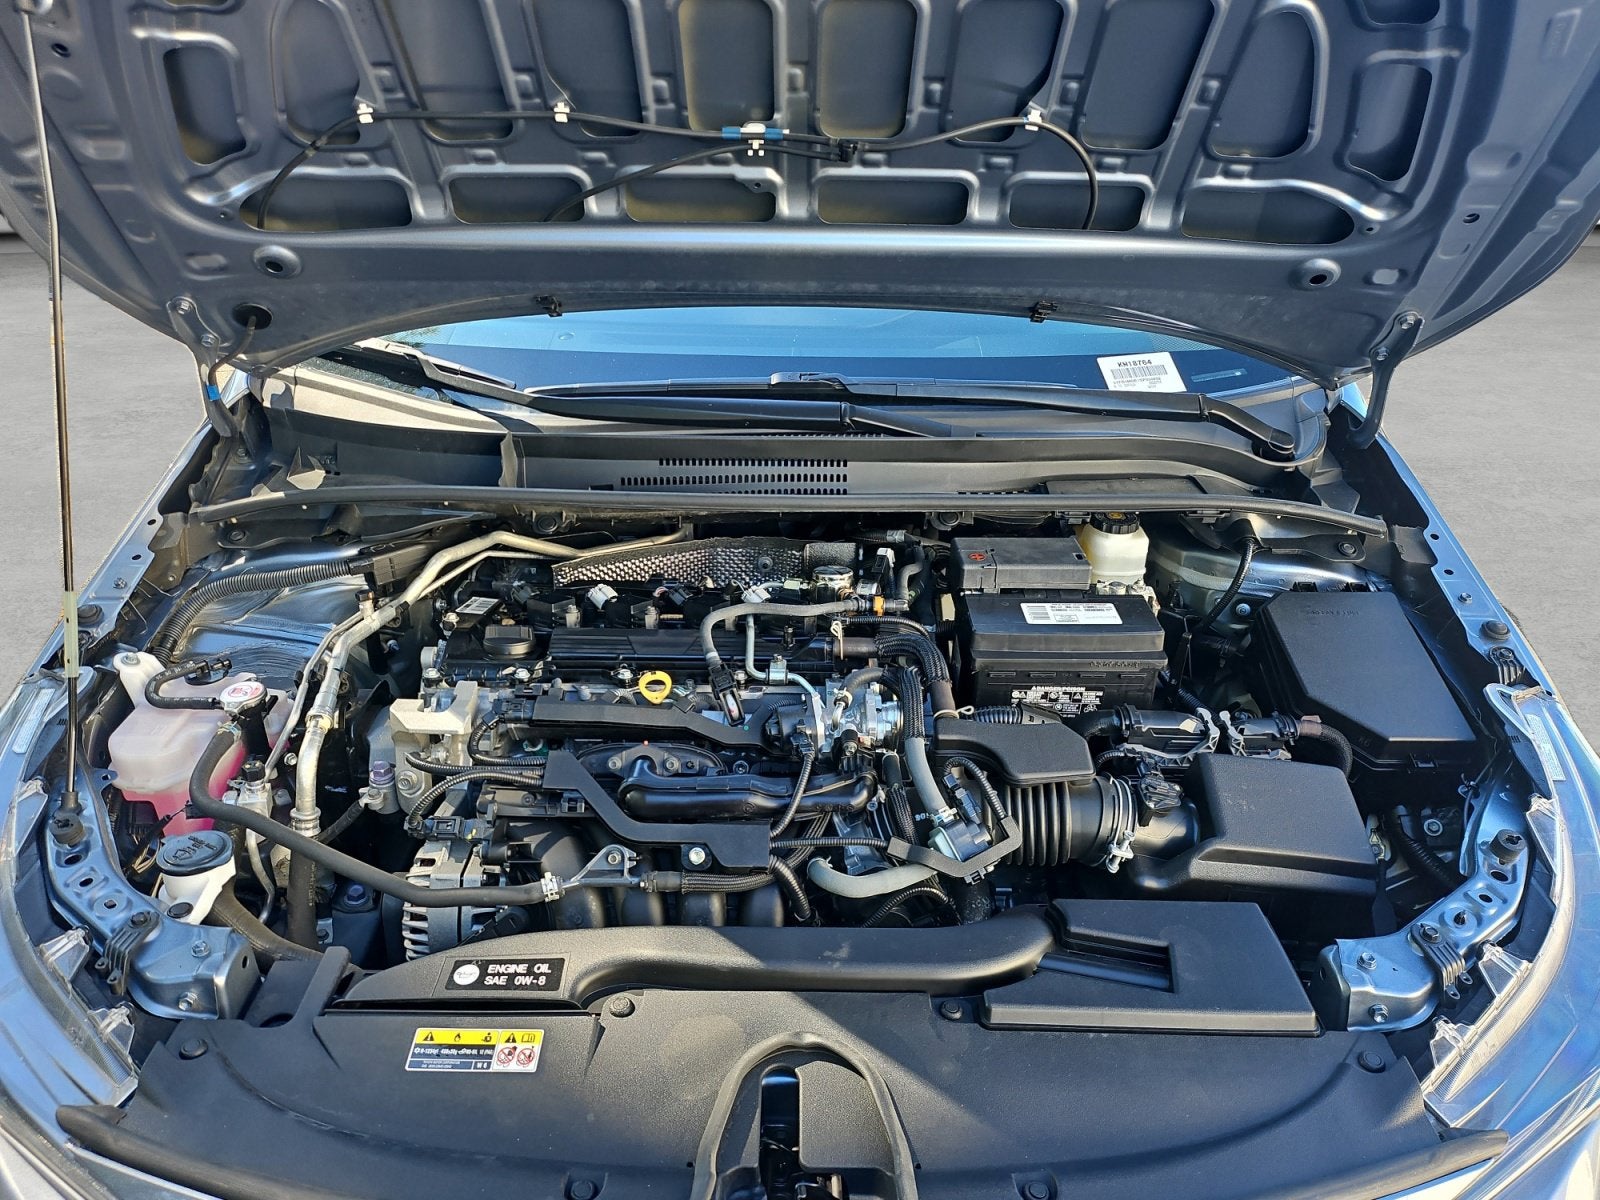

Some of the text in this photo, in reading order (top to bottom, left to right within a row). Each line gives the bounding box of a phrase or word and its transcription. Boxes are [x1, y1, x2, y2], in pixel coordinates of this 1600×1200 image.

[487, 963, 552, 974] ENGINE OIL
[484, 975, 547, 986] SAE 0W-8
